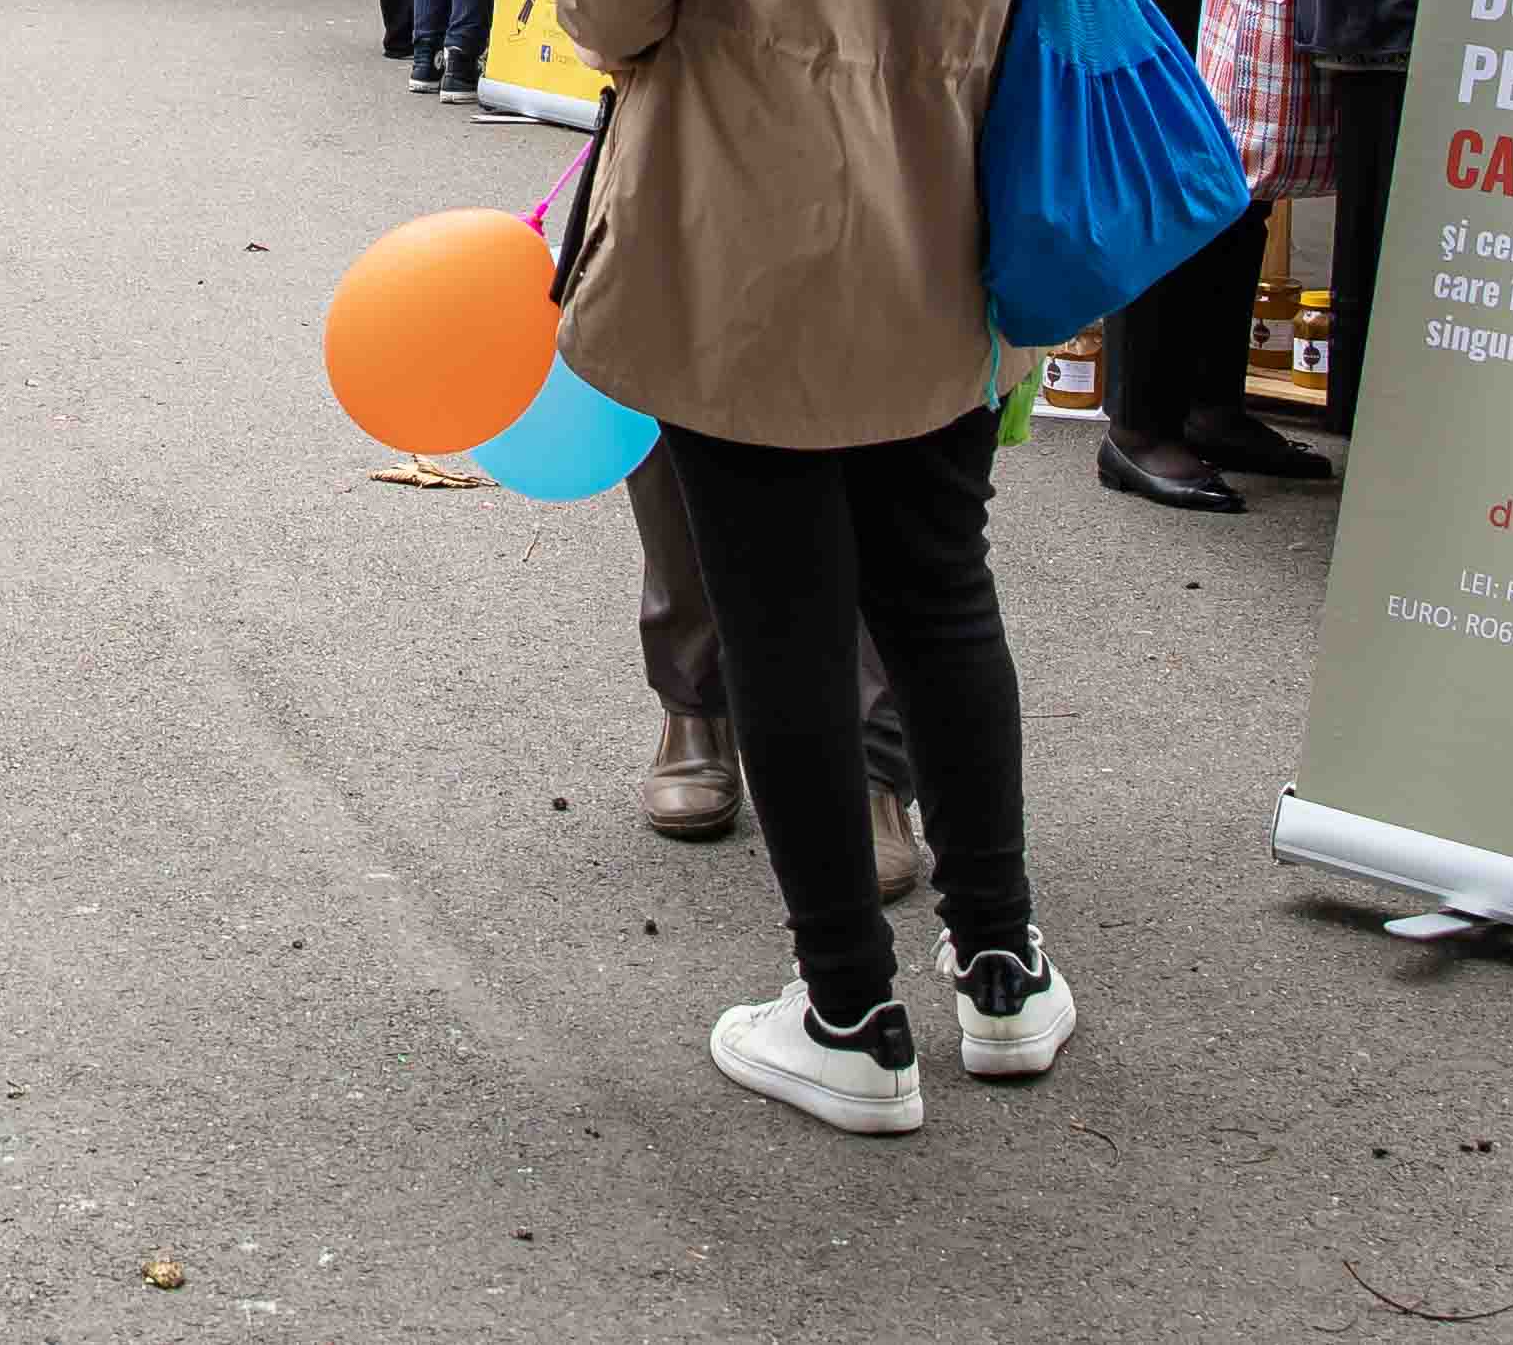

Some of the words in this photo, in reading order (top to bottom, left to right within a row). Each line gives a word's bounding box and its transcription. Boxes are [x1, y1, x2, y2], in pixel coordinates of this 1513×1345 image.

[1433, 272, 1501, 308] care
[1459, 569, 1501, 599] LEI:
[1386, 595, 1459, 631] EURO:
